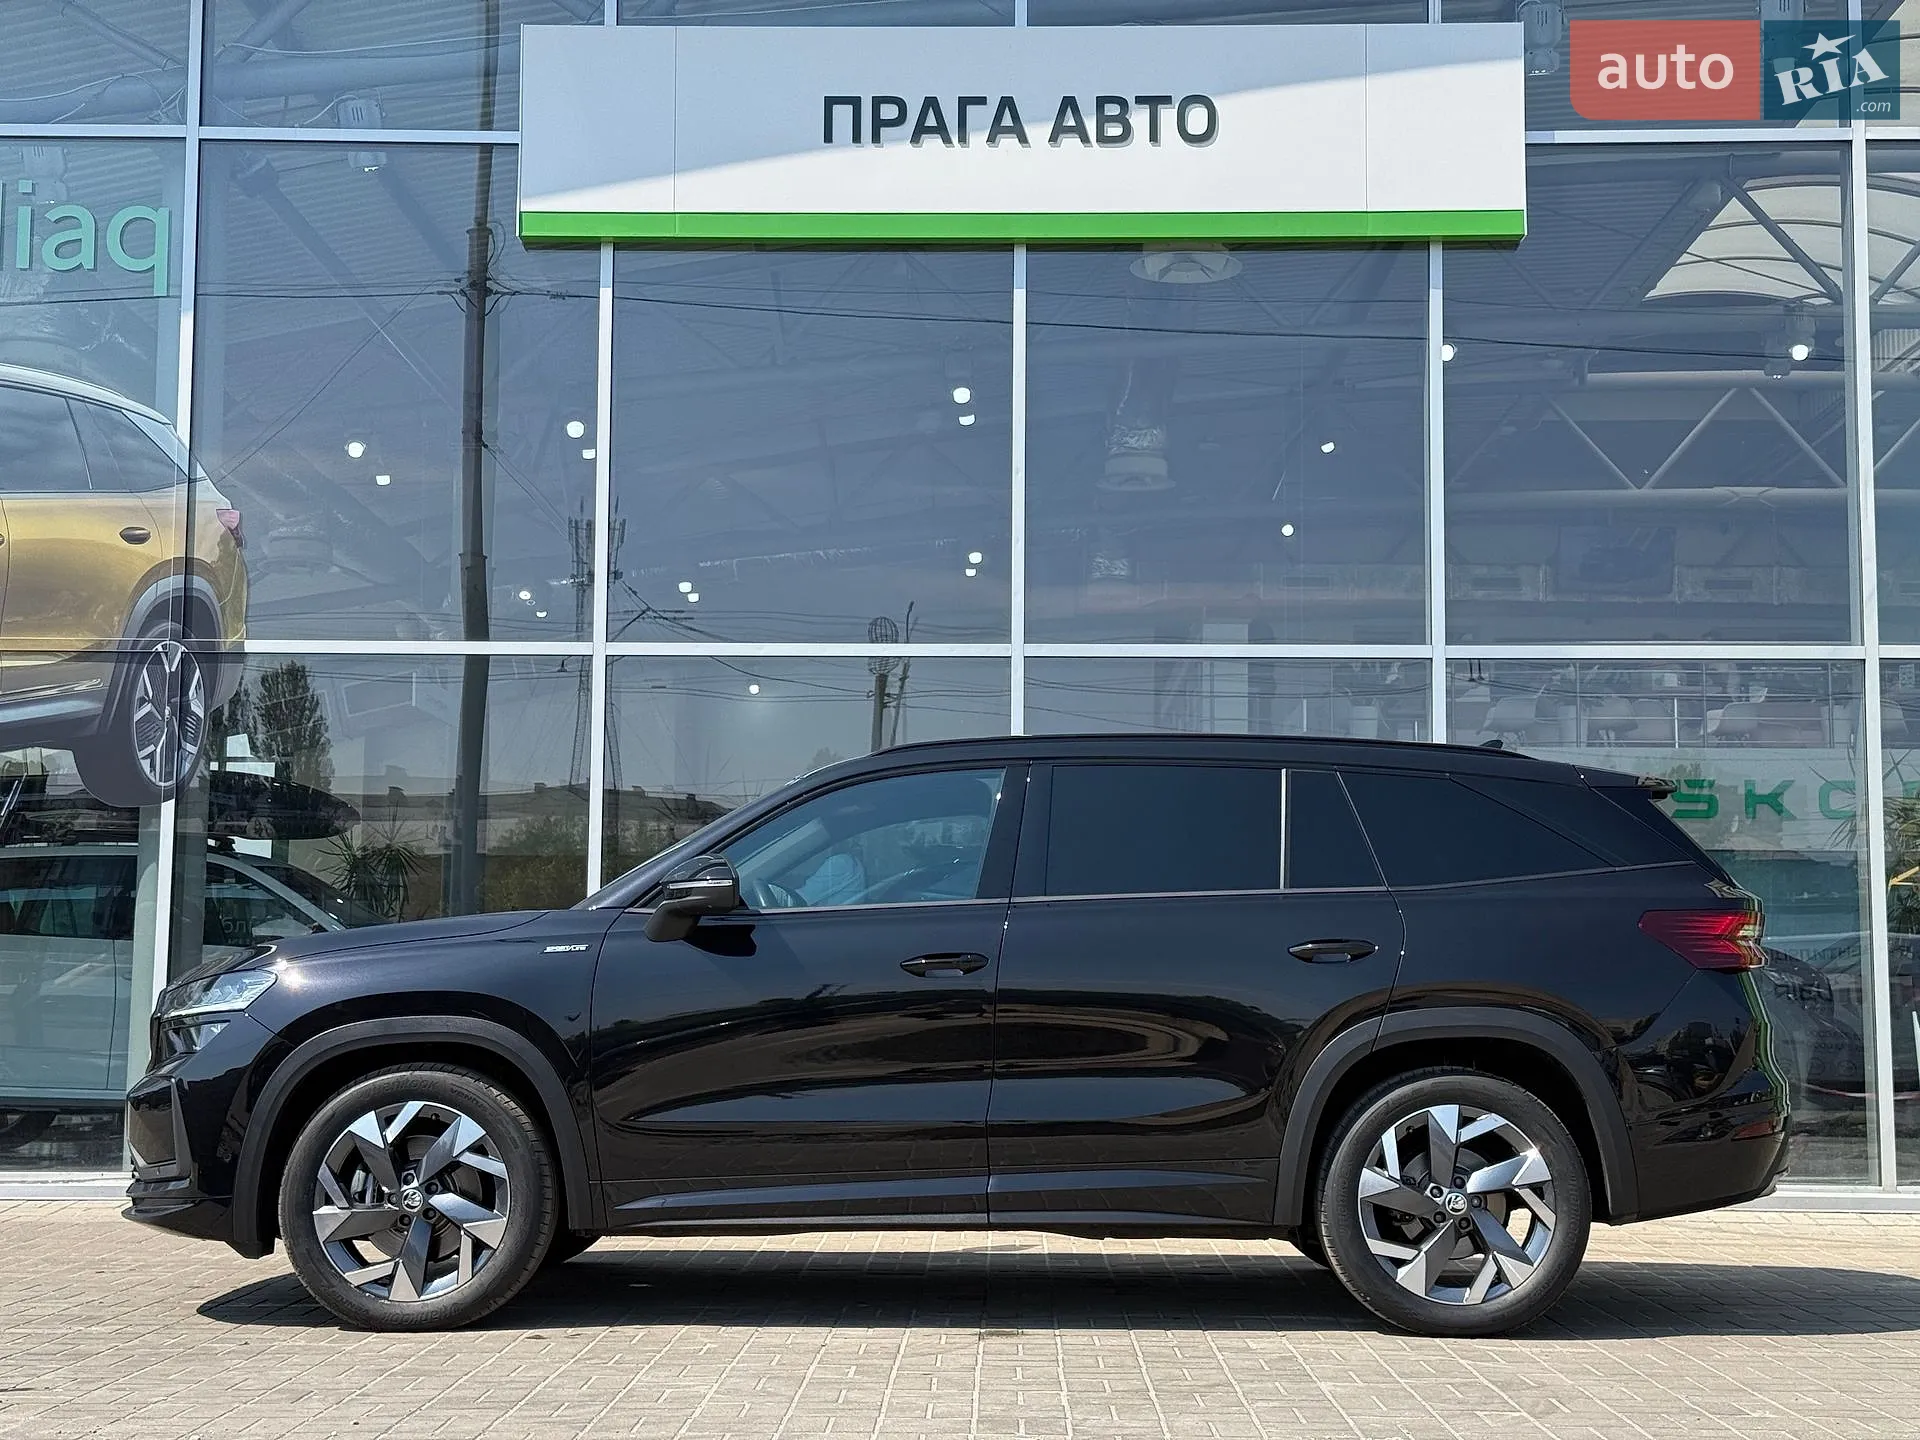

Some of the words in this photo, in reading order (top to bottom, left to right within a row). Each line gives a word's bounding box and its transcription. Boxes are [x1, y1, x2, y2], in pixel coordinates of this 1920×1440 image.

[823, 95, 1030, 147] ПРАГА
[1048, 94, 1219, 147] АВТО
[0, 180, 169, 296] iaq
